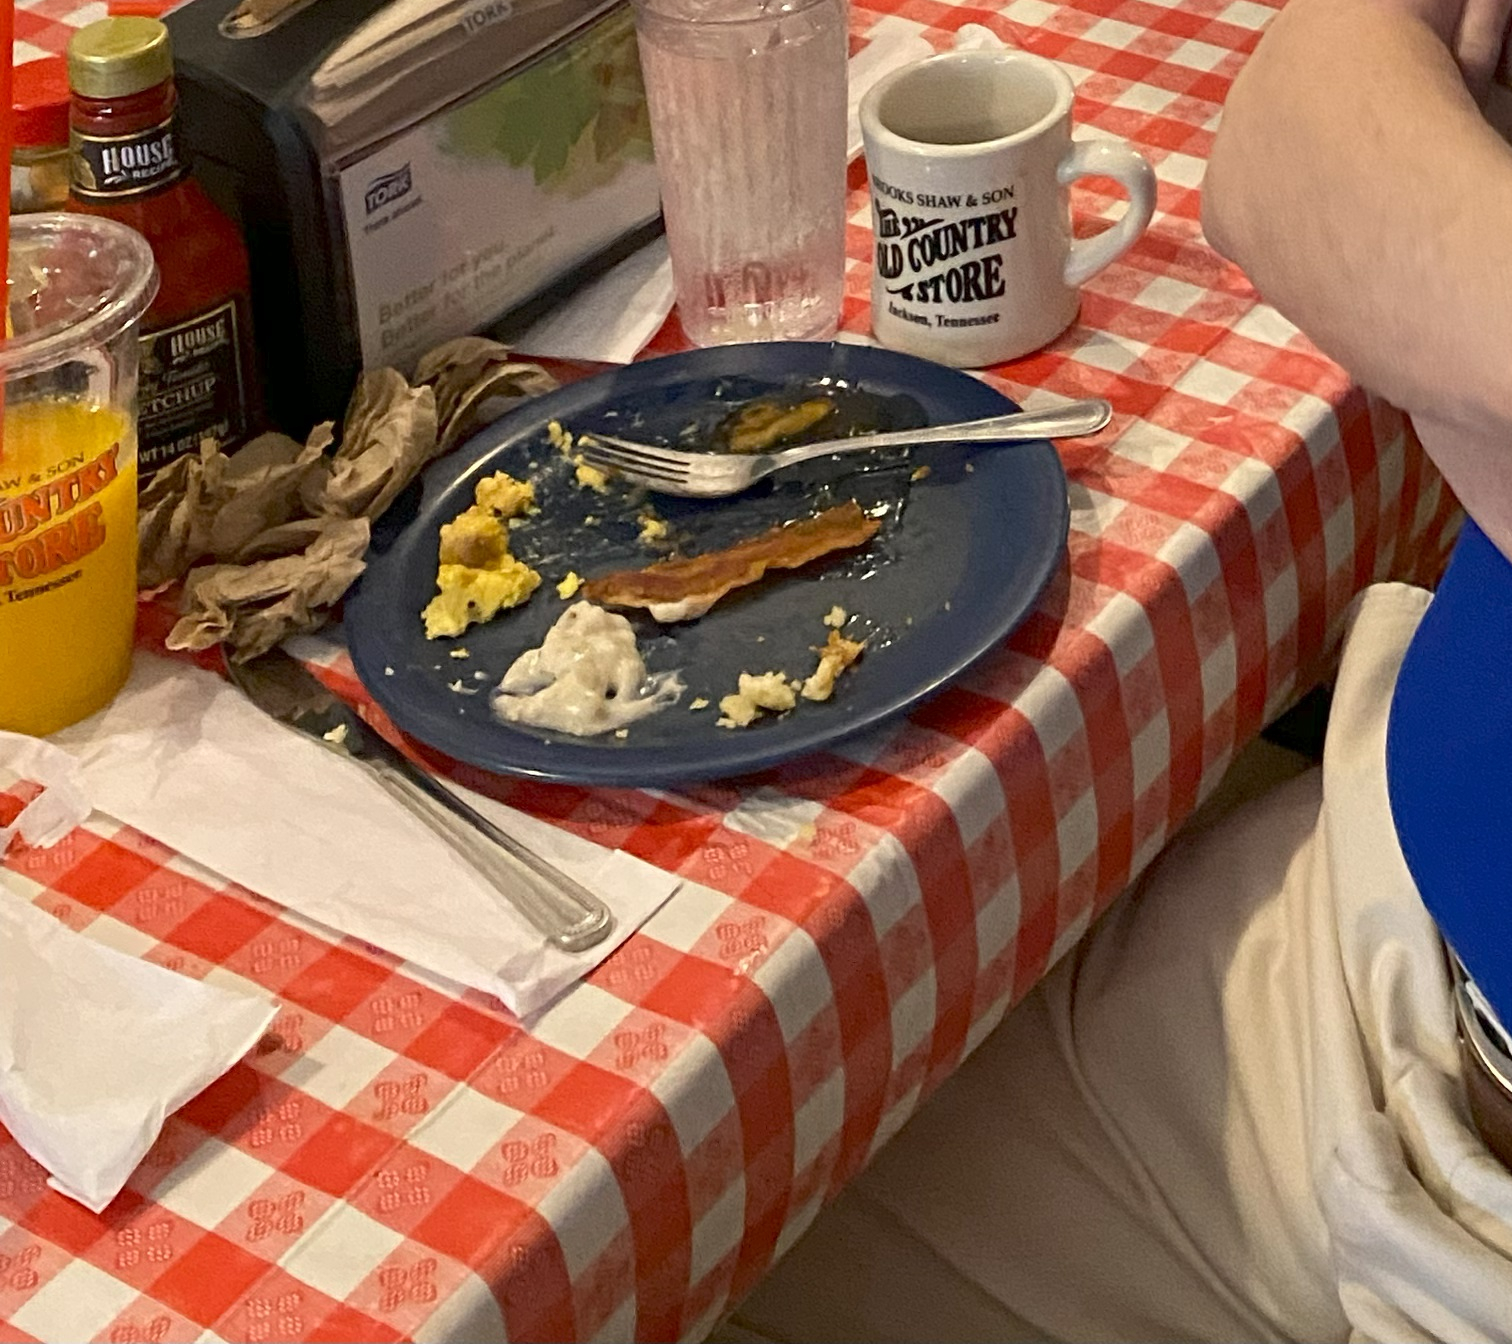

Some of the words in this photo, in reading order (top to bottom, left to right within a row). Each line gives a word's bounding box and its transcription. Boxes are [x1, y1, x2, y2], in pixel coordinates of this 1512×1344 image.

[464, 3, 510, 32] TORK
[101, 133, 173, 175] HOUSE
[916, 193, 962, 209] SHAW
[965, 194, 979, 208] &
[981, 184, 1016, 206] SON
[907, 206, 1018, 273] COUNTRY
[916, 253, 1006, 304] STORE
[888, 301, 934, 329] Jackson,
[934, 312, 1001, 328] Tennessee
[170, 317, 226, 358] HOUSE
[46, 451, 85, 478] SON
